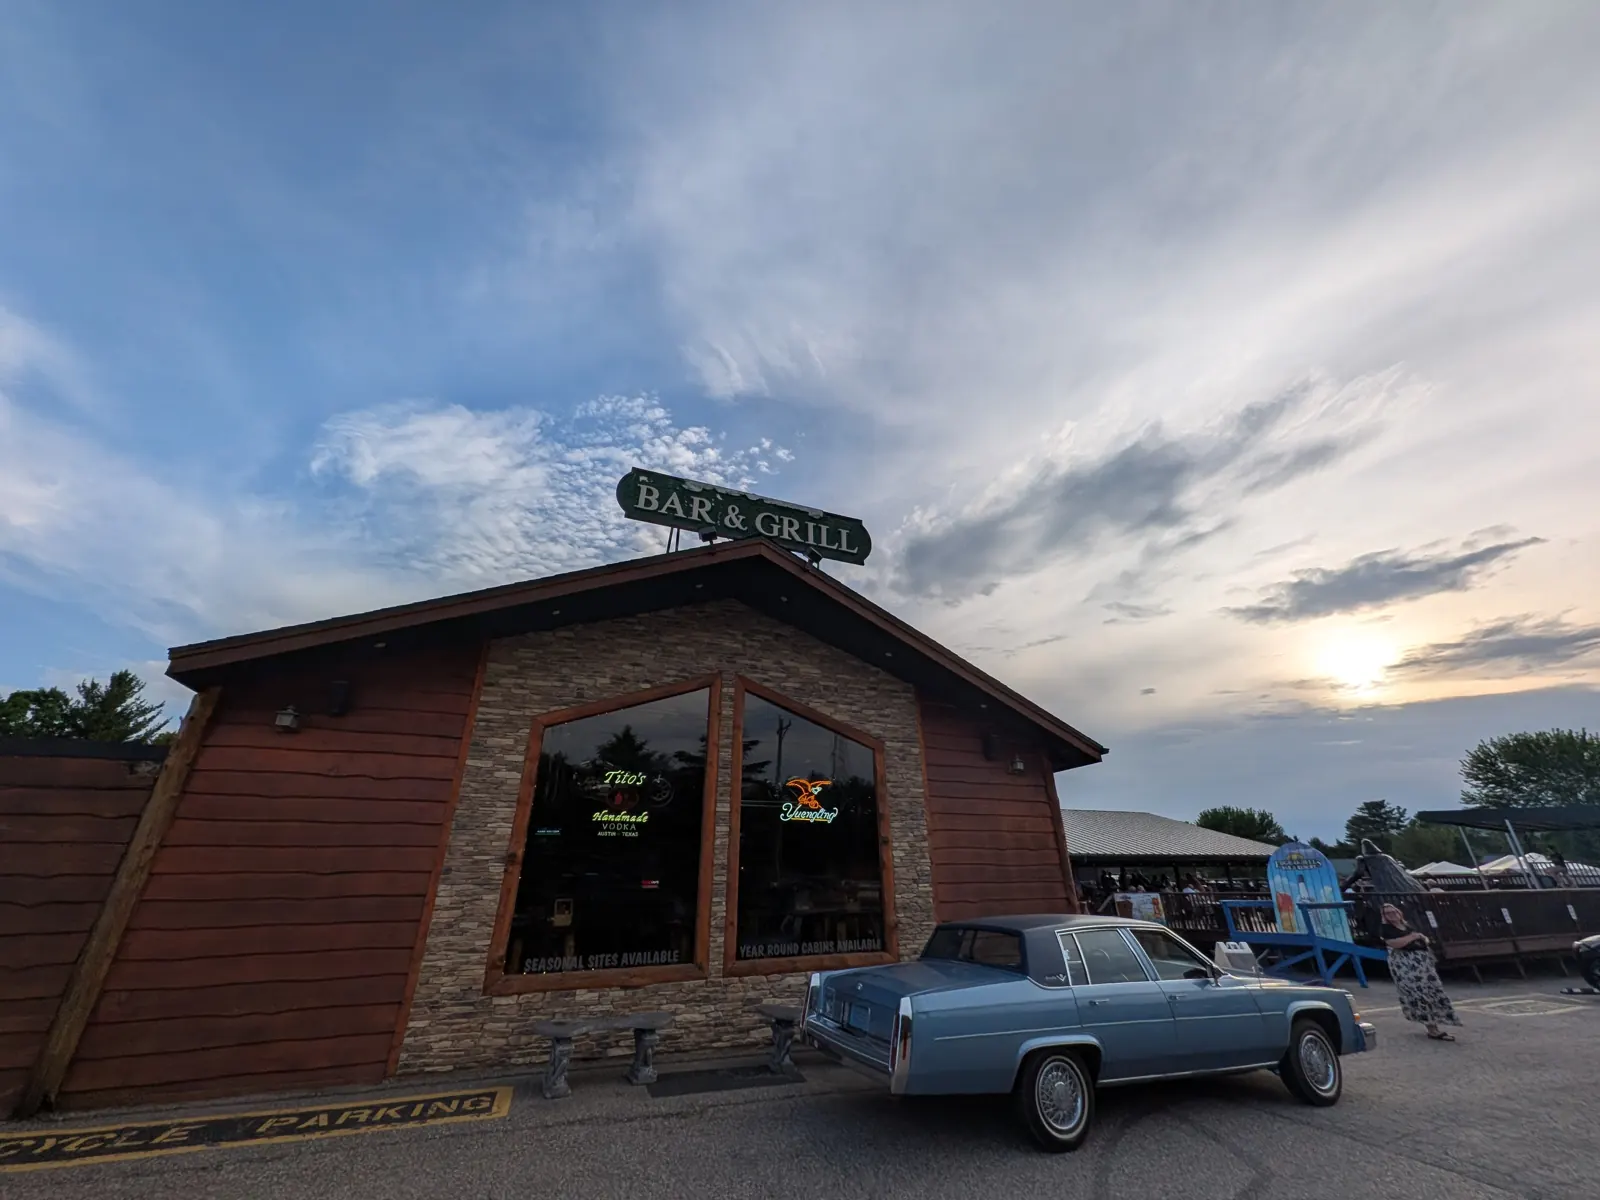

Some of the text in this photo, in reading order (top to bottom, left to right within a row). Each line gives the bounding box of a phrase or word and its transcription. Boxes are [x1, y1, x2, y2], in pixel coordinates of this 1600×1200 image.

[633, 483, 859, 554] BAR & GRILL
[603, 769, 647, 785] Tito's
[592, 809, 649, 823] Handmade
[780, 802, 839, 824] Yuengling
[602, 823, 637, 831] VODKA
[739, 938, 881, 958] YEAR ROUND CABINS AVAILABLE
[524, 950, 680, 973] SEASONAL SITES AVAILABLE
[255, 1096, 492, 1133] PARKING
